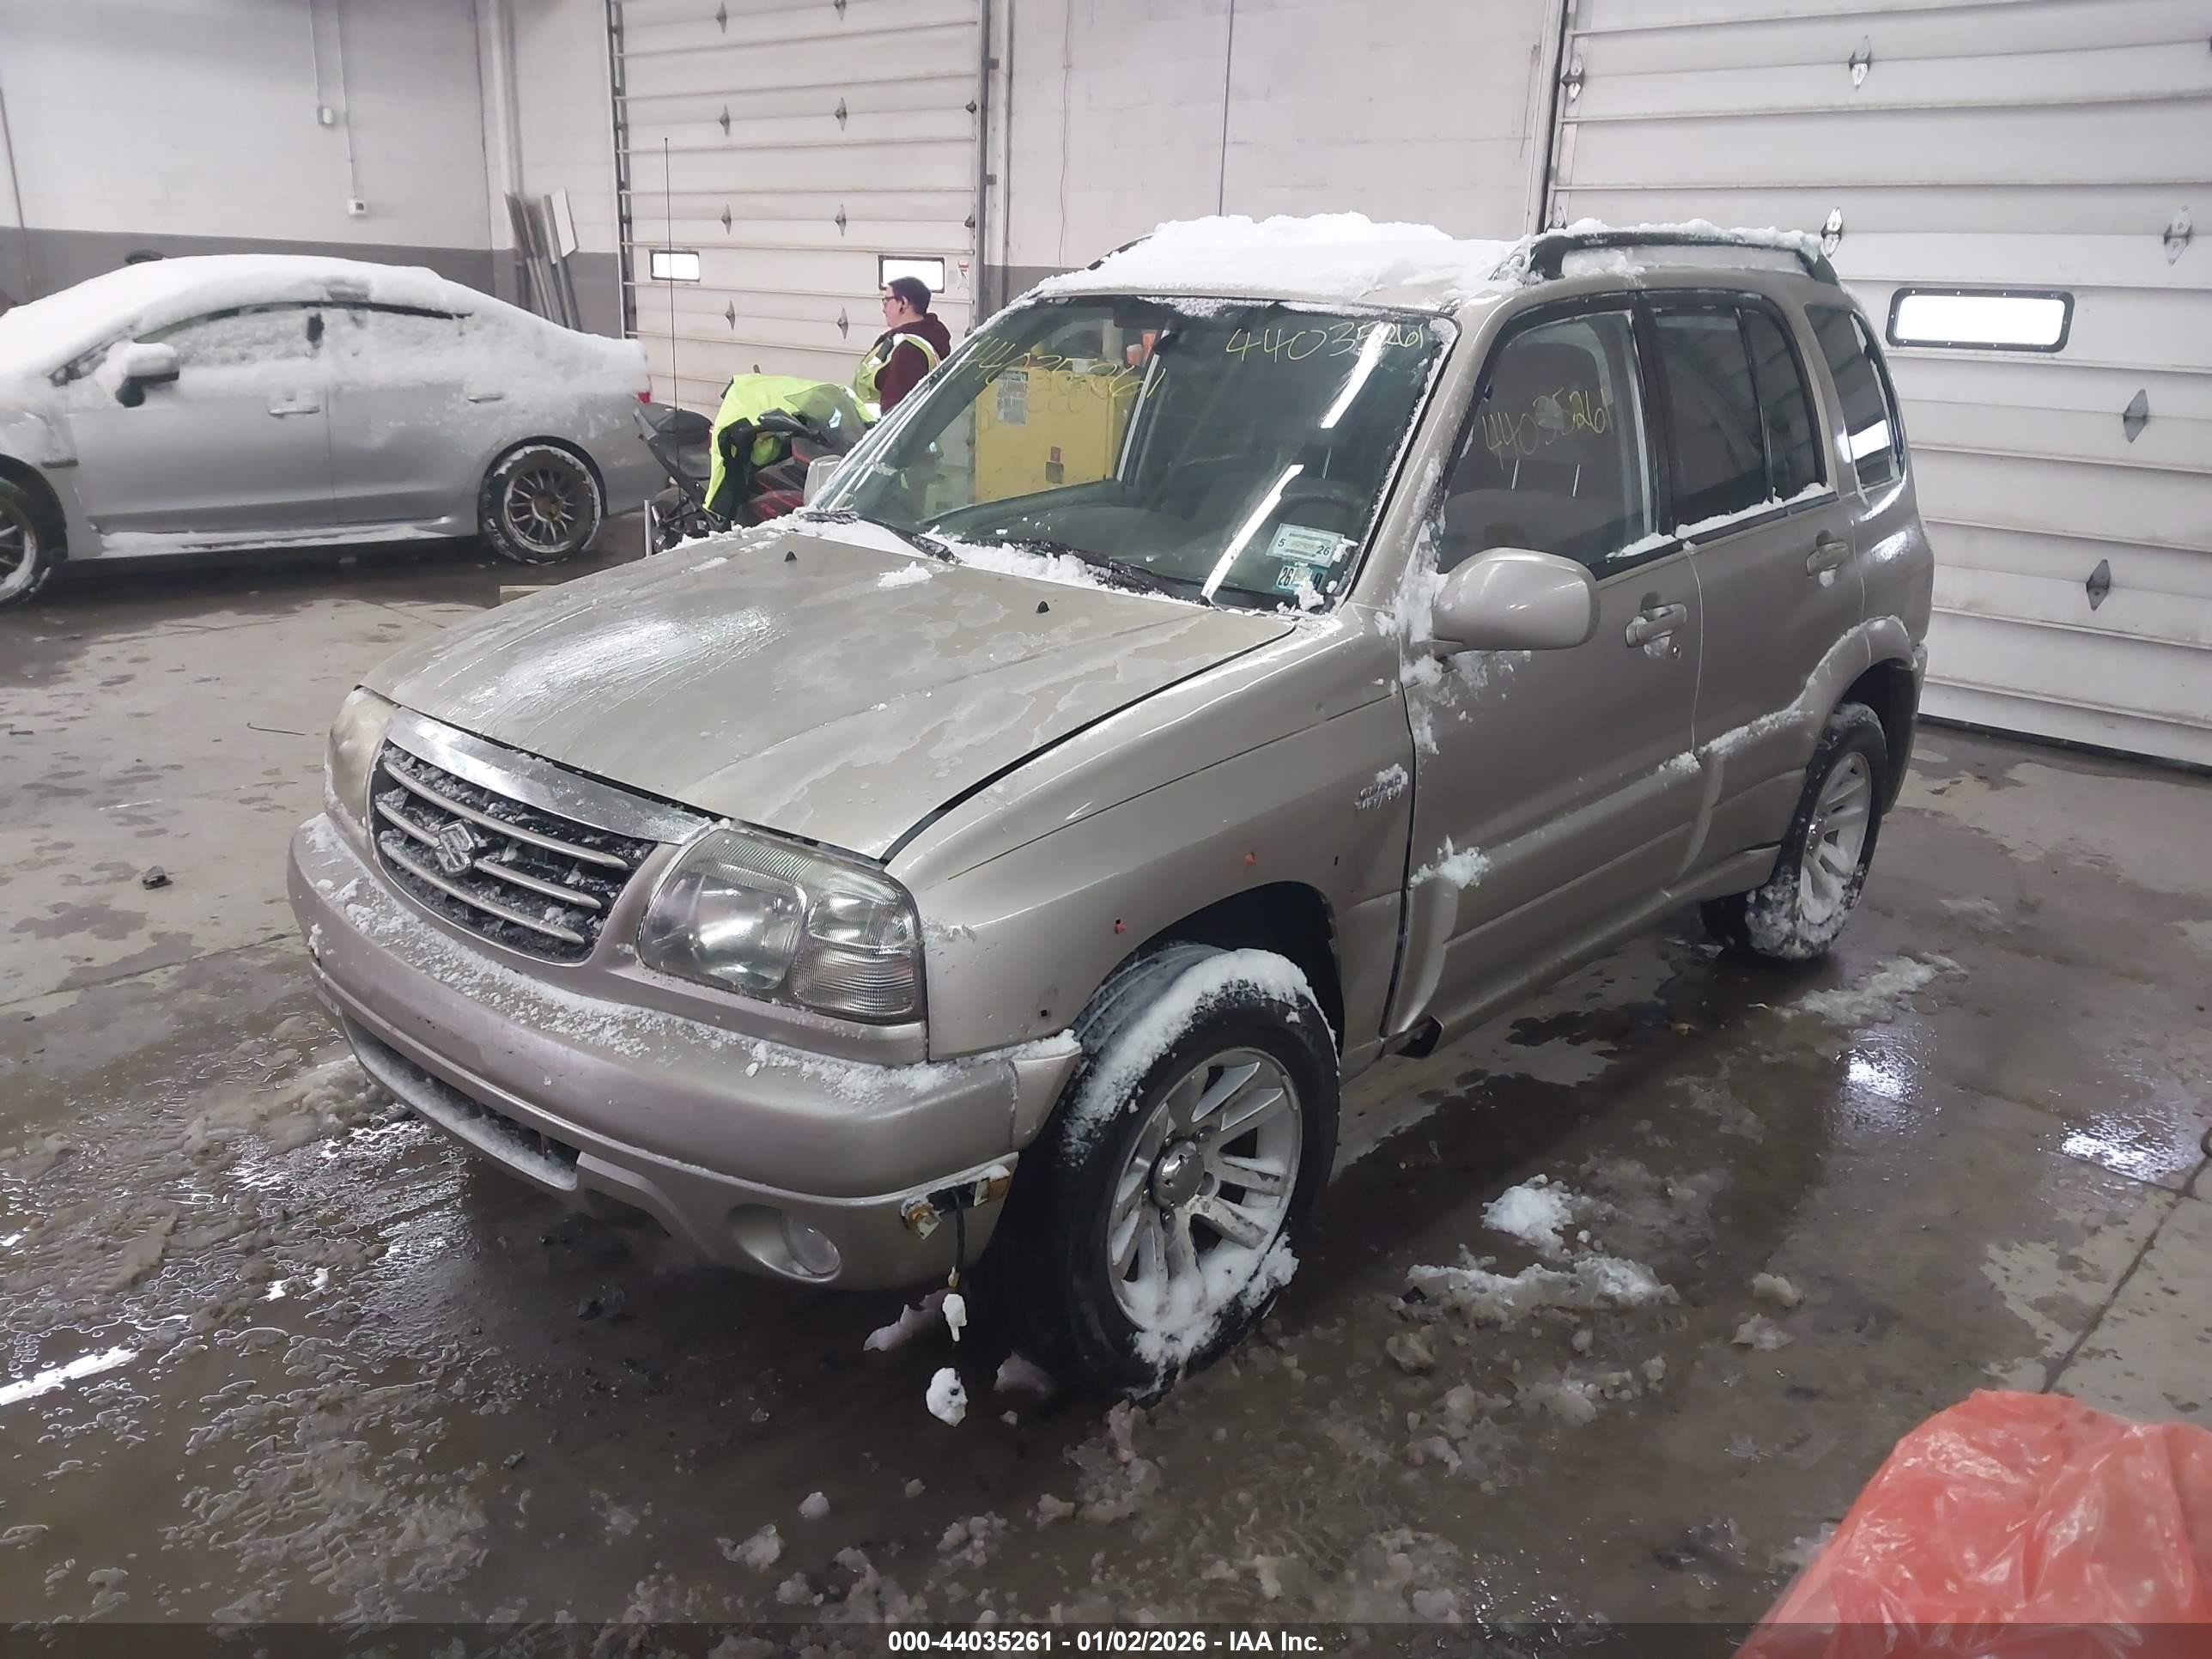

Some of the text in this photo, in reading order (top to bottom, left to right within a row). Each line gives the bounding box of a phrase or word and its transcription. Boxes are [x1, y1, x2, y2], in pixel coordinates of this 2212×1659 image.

[1277, 538, 1286, 548] 5
[1316, 544, 1331, 556] 26
[1277, 567, 1294, 586] 26
